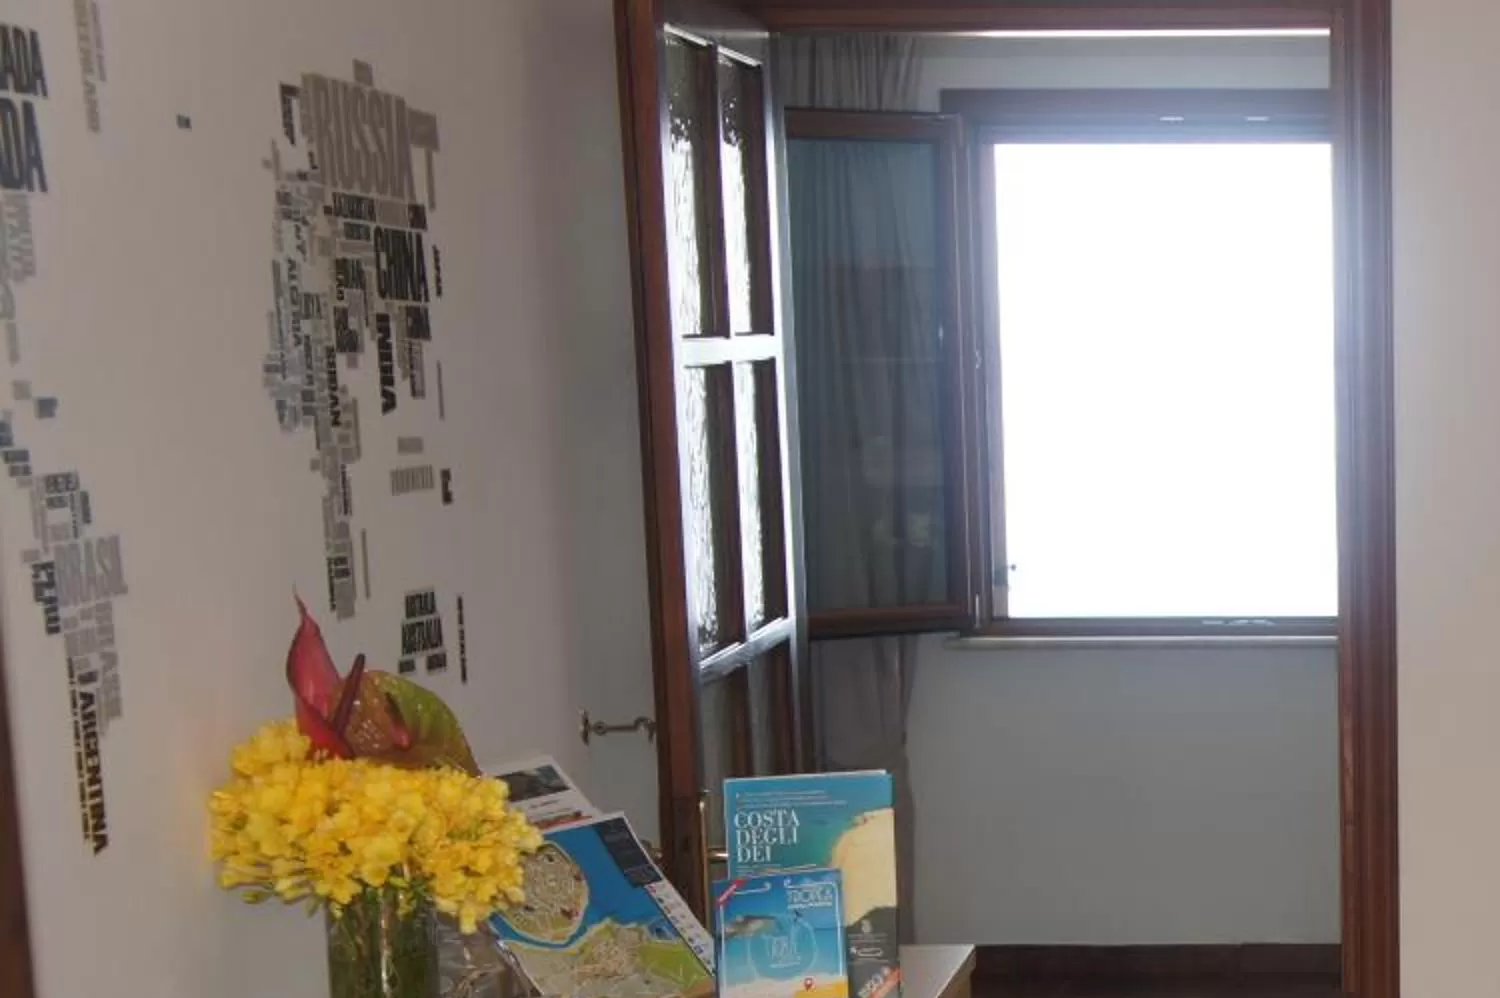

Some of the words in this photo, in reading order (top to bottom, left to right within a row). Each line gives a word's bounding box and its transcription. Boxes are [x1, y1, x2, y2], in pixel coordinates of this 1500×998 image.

[79, 690, 109, 856] ARGENTINA
[734, 808, 800, 829] COSTA
[736, 827, 798, 847] DEGLI
[736, 844, 772, 864] DEI
